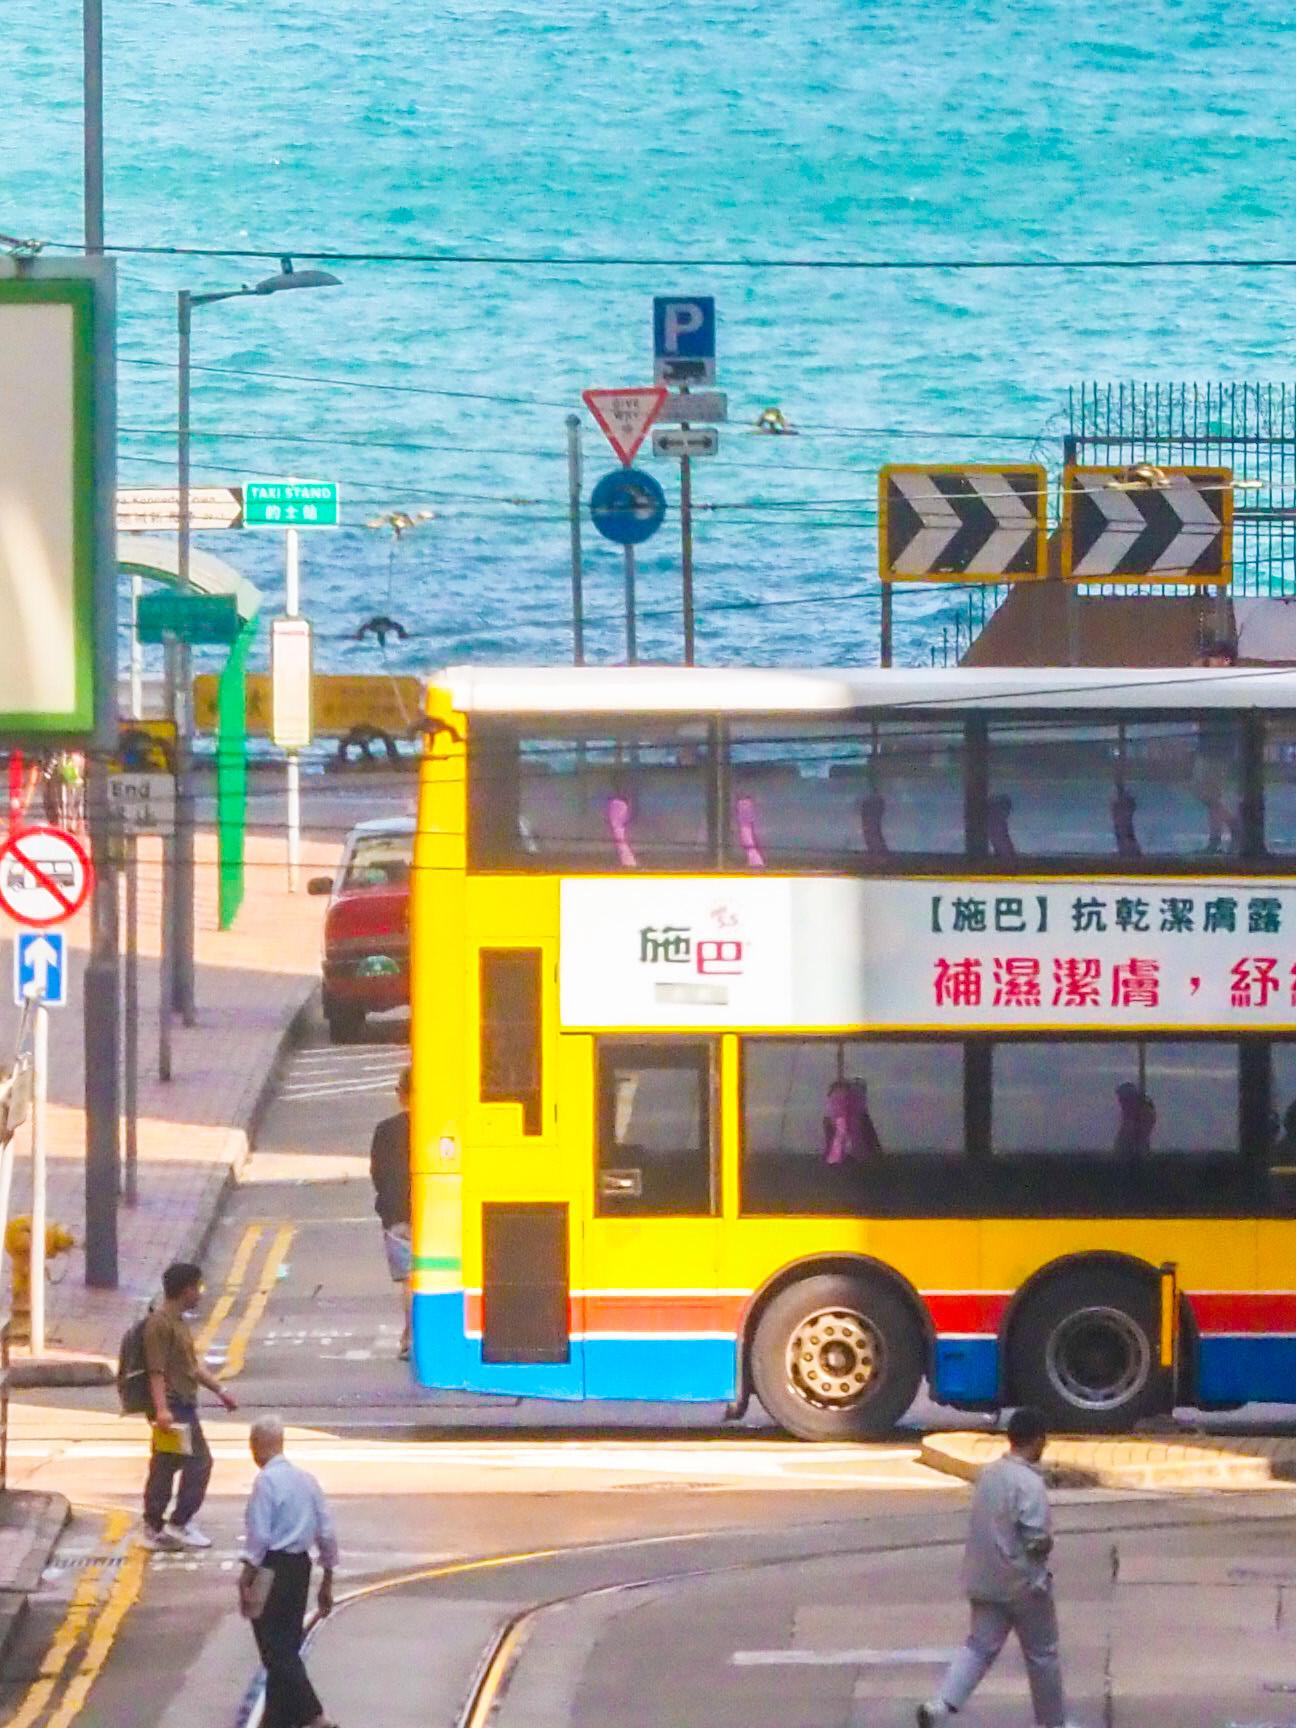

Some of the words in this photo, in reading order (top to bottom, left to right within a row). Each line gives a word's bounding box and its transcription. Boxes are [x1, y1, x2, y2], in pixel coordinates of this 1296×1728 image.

[665, 303, 702, 353] P
[612, 399, 640, 409] GIVE
[252, 487, 281, 500] TAXI
[285, 487, 332, 500] STAND
[639, 926, 743, 975] 施巴
